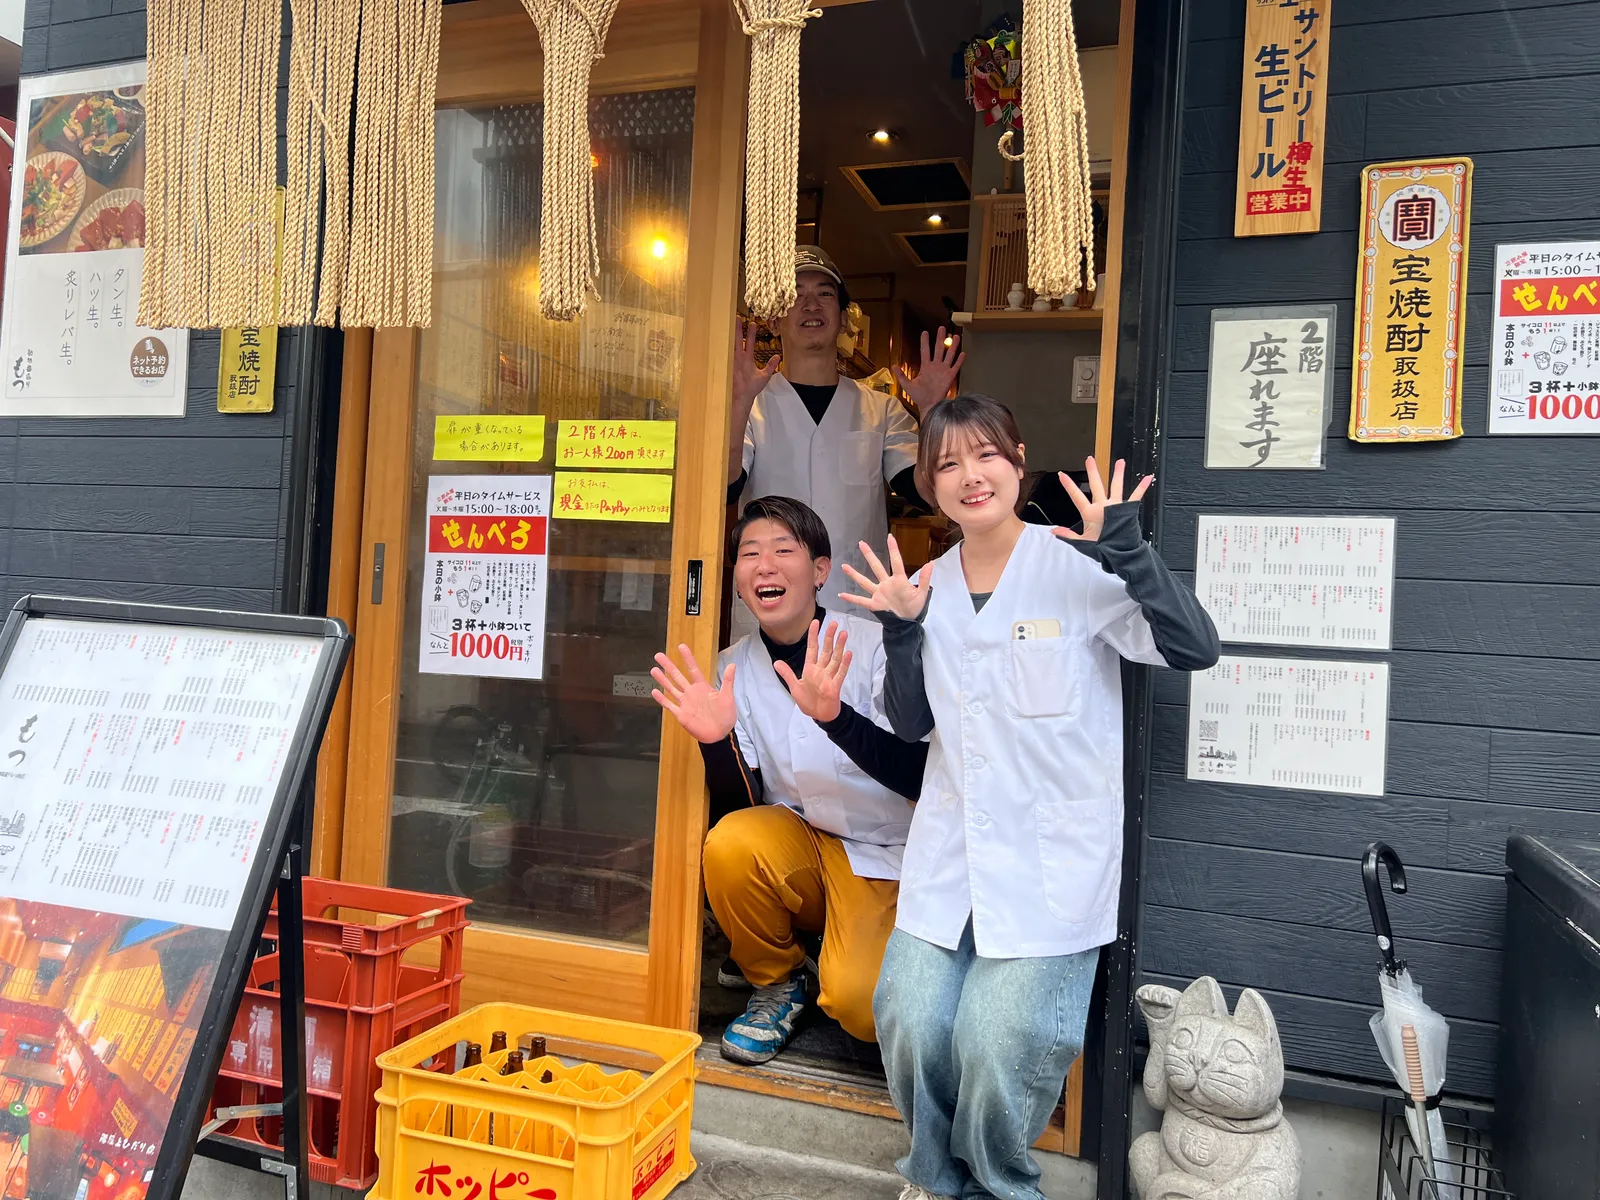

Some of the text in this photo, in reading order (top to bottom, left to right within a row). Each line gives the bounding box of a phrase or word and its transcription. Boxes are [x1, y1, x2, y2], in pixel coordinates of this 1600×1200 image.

[1250, 44, 1290, 179] 生ビール
[1282, 141, 1313, 189] 樽生
[1249, 191, 1309, 212] 営業中
[86, 272, 101, 329] ハツ生。
[110, 268, 124, 327] タン生。
[132, 355, 166, 365] ネット予約
[237, 327, 261, 395] 宝焼酎
[1298, 320, 1325, 374] 2階
[1504, 323, 1515, 366] 本日の小鉢
[132, 365, 166, 375] できるお店
[228, 374, 237, 399] 取扱店
[1239, 331, 1289, 468] 座れます
[1499, 405, 1525, 413] なんと
[459, 440, 524, 452] 場合があります。
[454, 490, 541, 501] 平日のタイムサービス
[441, 518, 532, 551] せんべろ
[434, 559, 444, 602] 本日の小鉢
[430, 641, 449, 650] なんと
[414, 1156, 557, 1200] ホッピー
